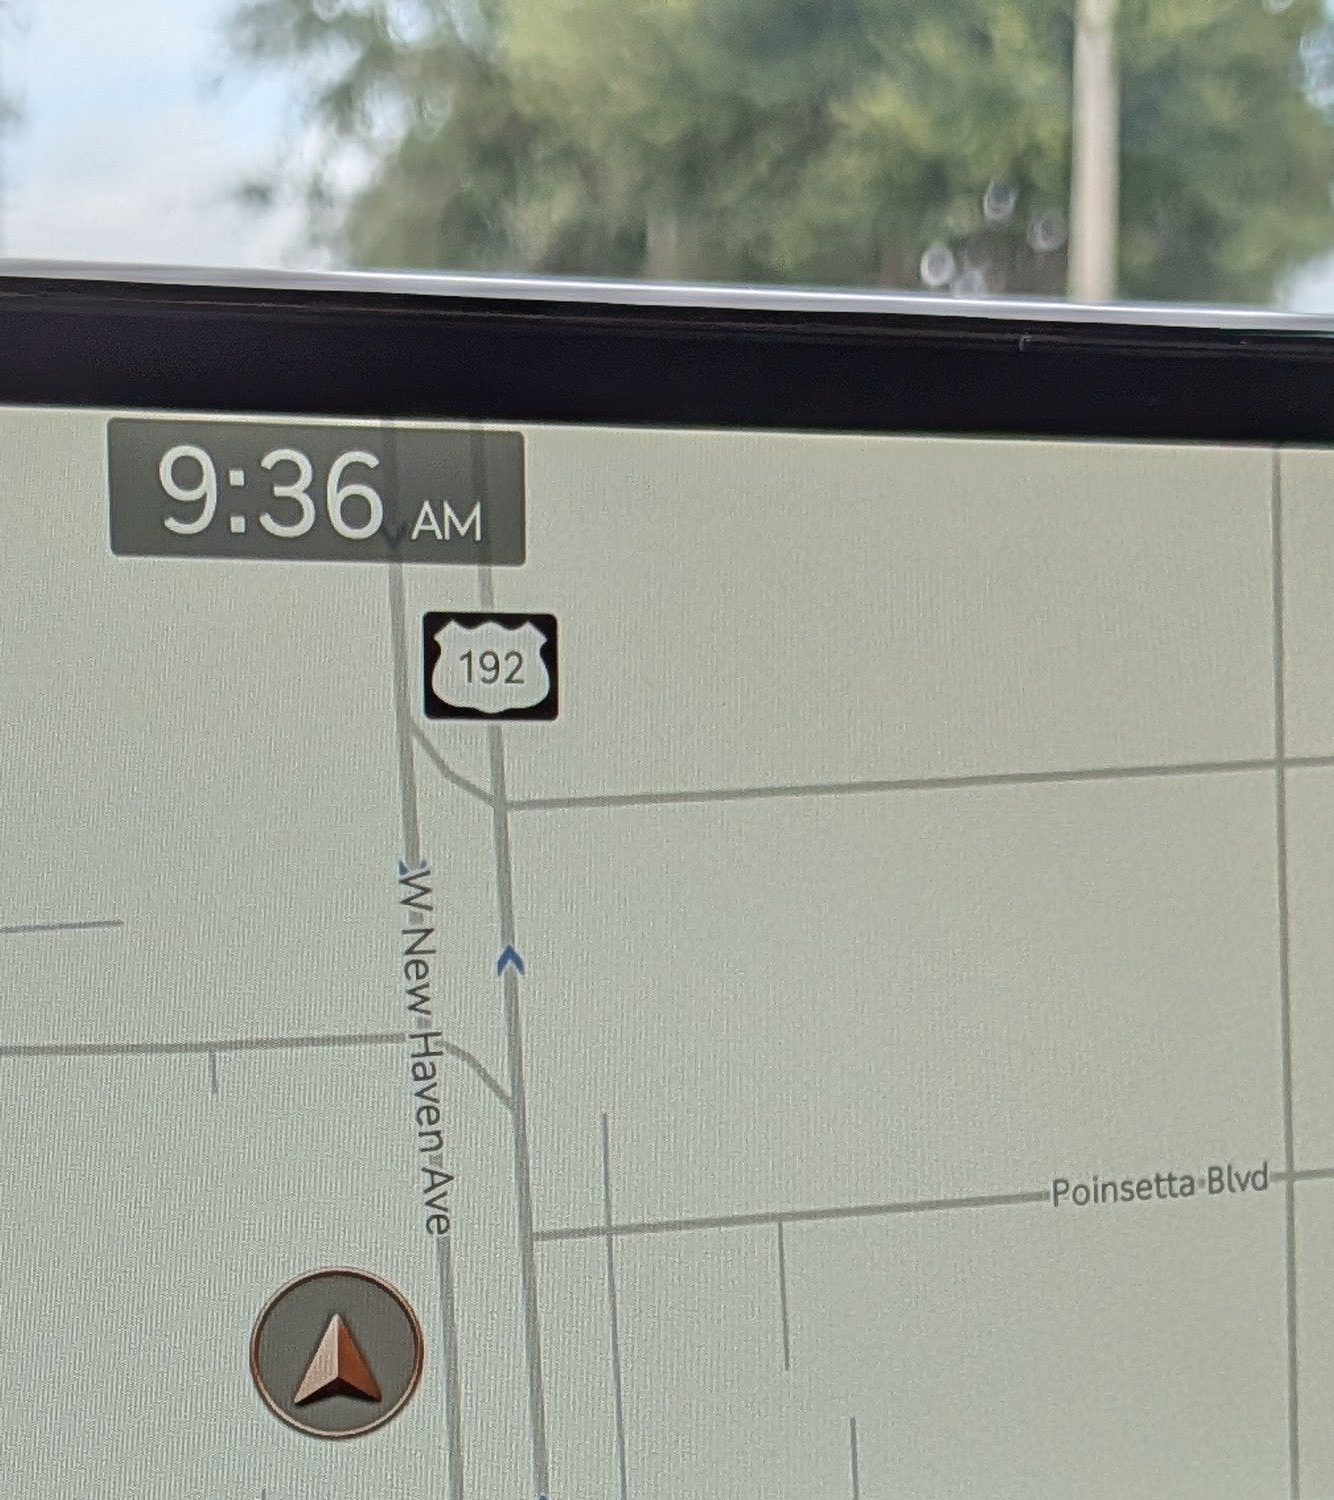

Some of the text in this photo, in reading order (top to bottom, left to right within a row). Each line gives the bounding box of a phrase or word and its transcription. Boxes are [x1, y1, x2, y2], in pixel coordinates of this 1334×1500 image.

[159, 444, 483, 542] 9:36 AM
[458, 650, 525, 685] 192
[398, 869, 455, 1236] W New Haven Ave
[1051, 1160, 1269, 1208] Poinsetta Blvd
